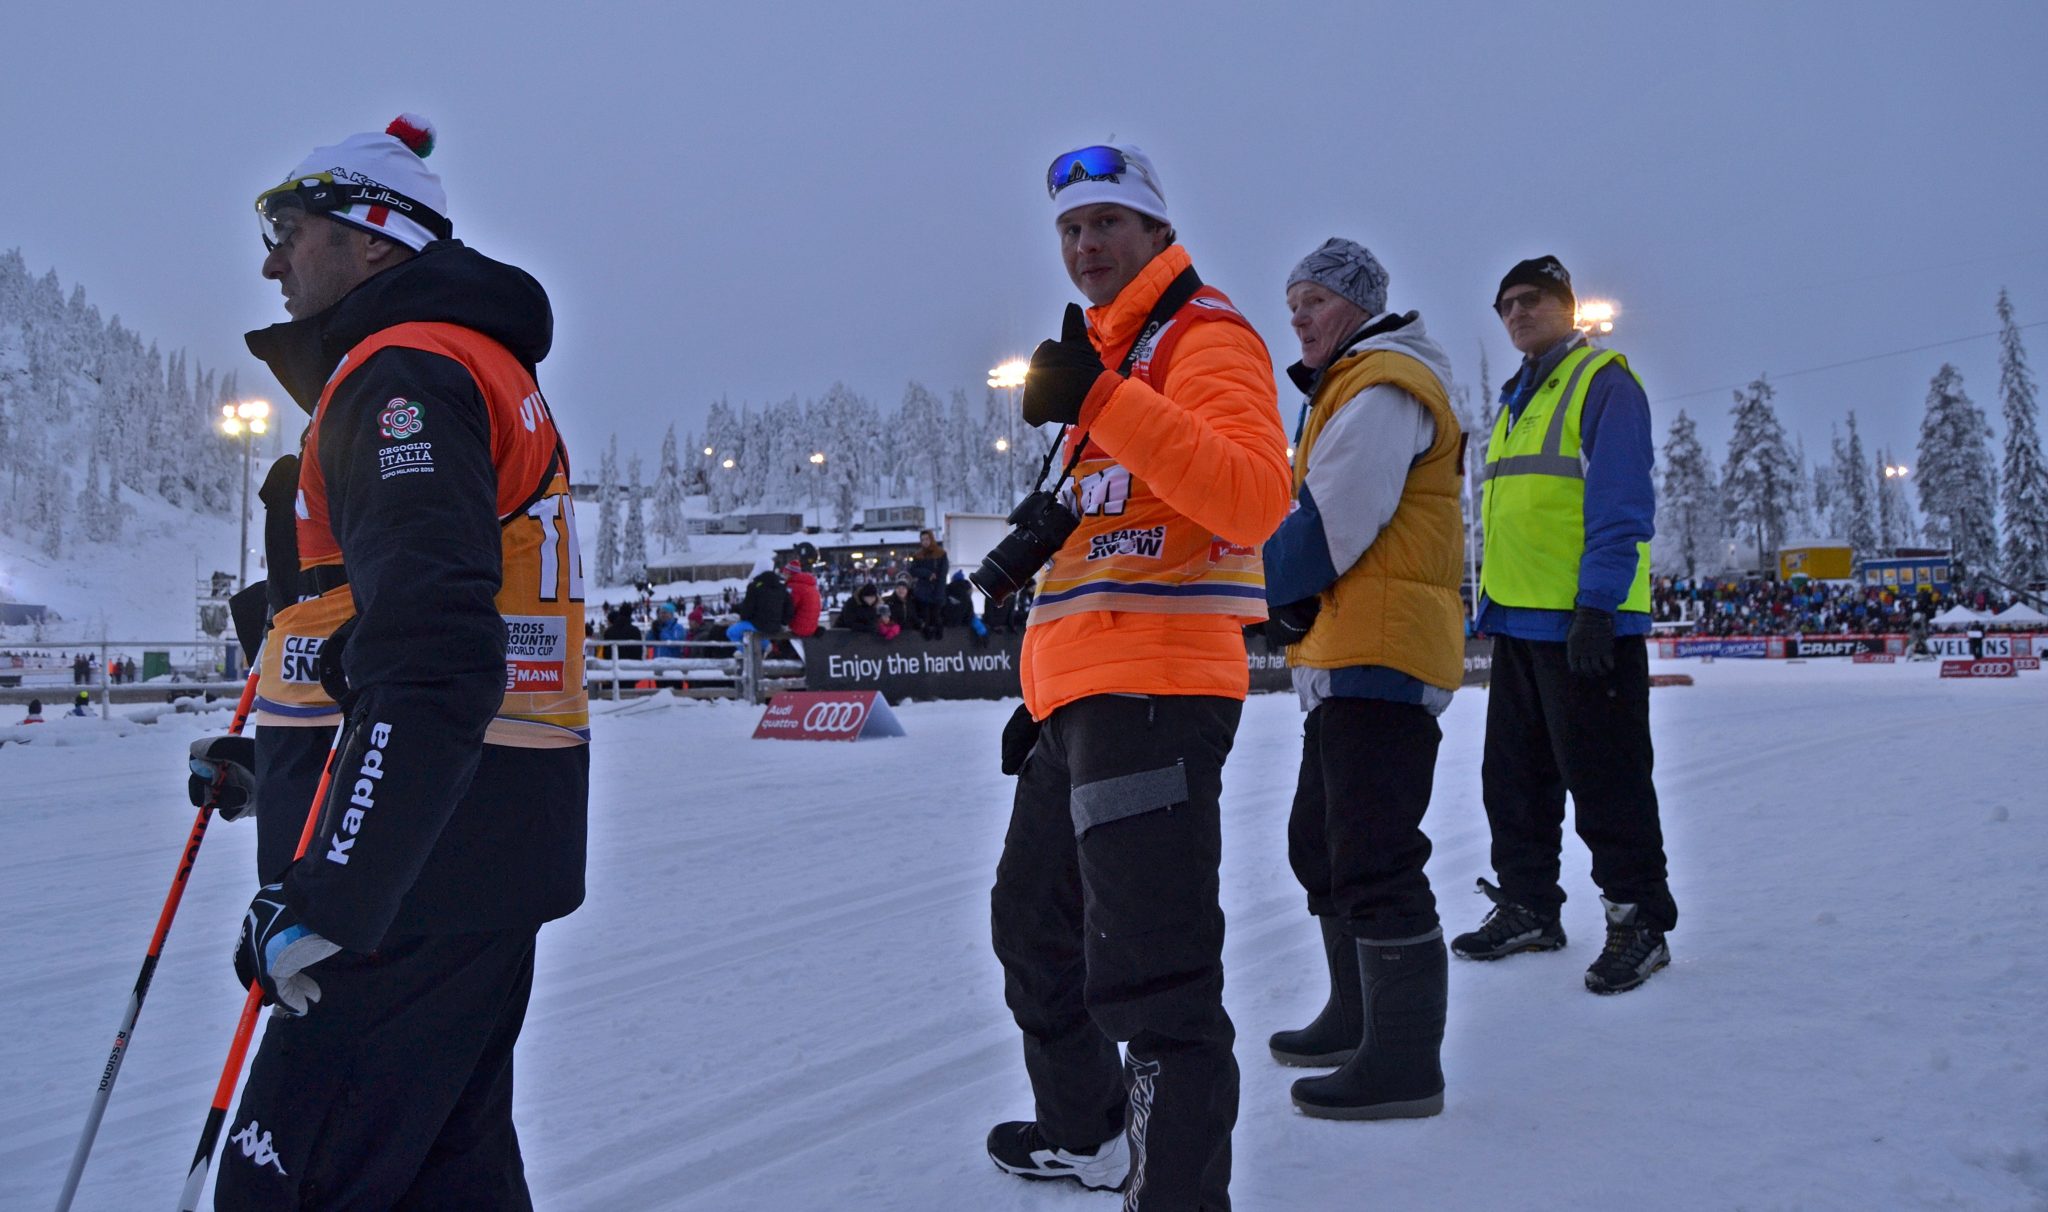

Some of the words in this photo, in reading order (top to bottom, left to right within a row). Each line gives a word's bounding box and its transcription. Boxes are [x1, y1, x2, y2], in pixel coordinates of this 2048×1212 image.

[351, 187, 413, 212] Julbo
[379, 442, 432, 456] ORGOGLIO
[380, 450, 433, 468] ITALIA
[507, 622, 545, 634] CROSS
[286, 637, 325, 656] CLE
[507, 634, 559, 646] OUNTRY
[1798, 642, 1851, 655] CRAFT
[1933, 639, 2009, 656] VELTNS
[507, 646, 535, 656] WORLD
[537, 646, 554, 656] CUP
[282, 655, 320, 681] SN
[829, 655, 882, 682] Enjoy
[887, 652, 920, 675] the
[924, 651, 965, 673] hard
[968, 650, 1011, 671] work
[767, 705, 794, 716] Audi
[761, 719, 799, 730] quattro
[326, 721, 393, 865] Kappa
[97, 1030, 127, 1093] ROSSIGNOL
